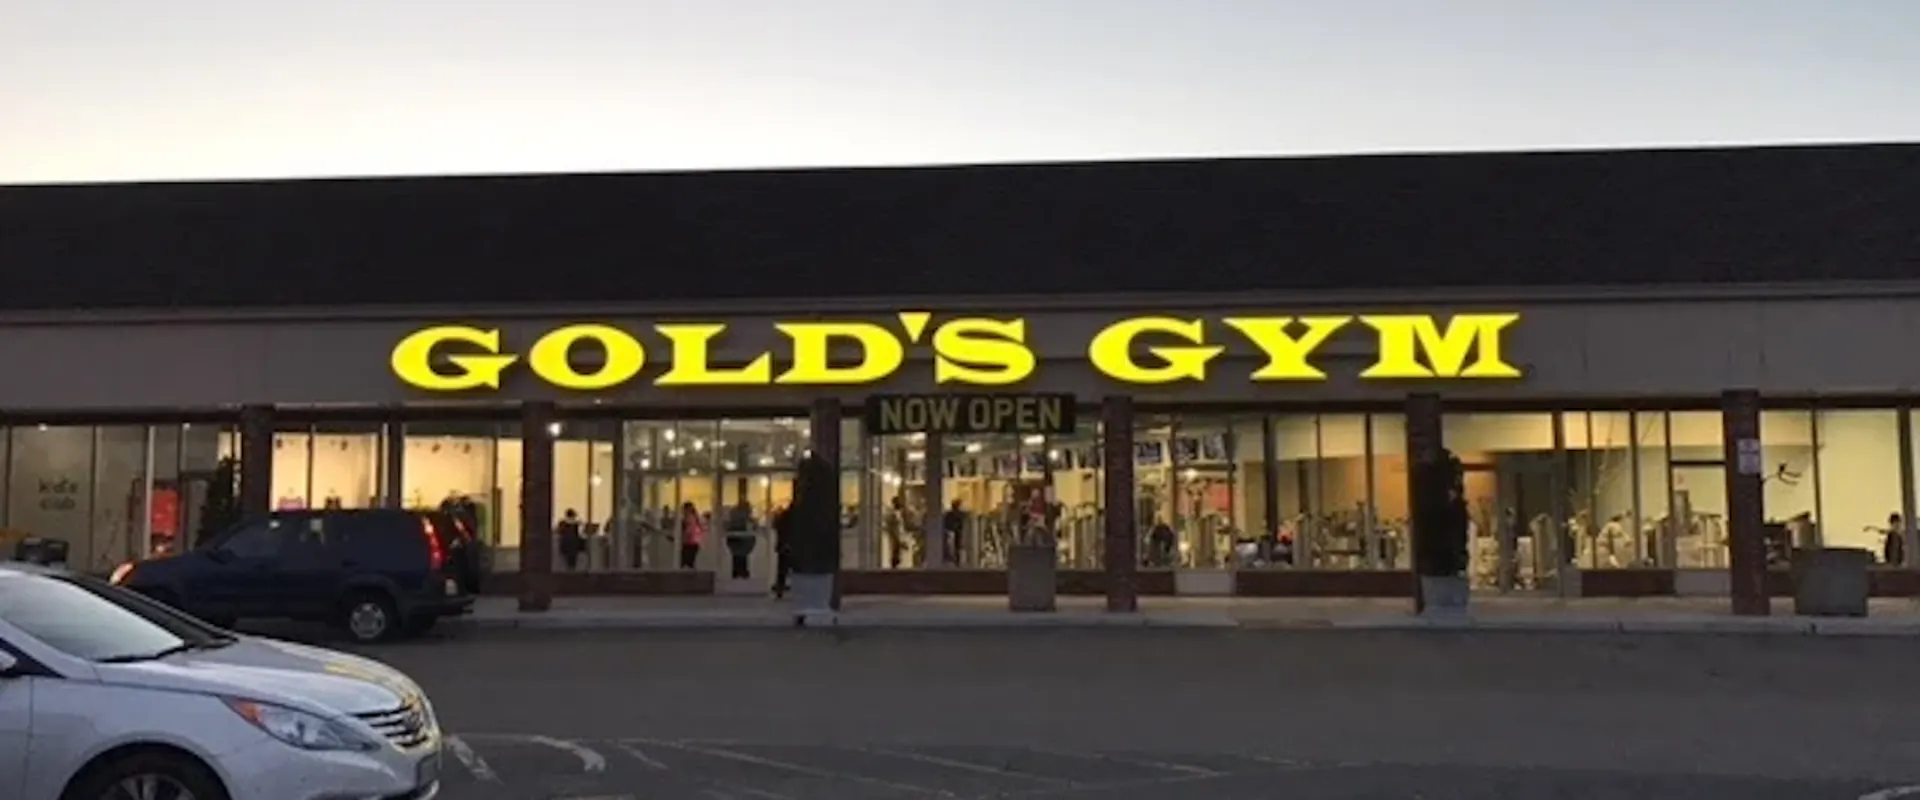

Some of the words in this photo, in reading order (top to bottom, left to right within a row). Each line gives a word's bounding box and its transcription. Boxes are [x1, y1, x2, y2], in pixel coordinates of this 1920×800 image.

[391, 312, 1035, 390] GOLD'S
[1089, 313, 1520, 383] GYM
[880, 397, 958, 430] NOW
[967, 396, 1062, 430] OPEN
